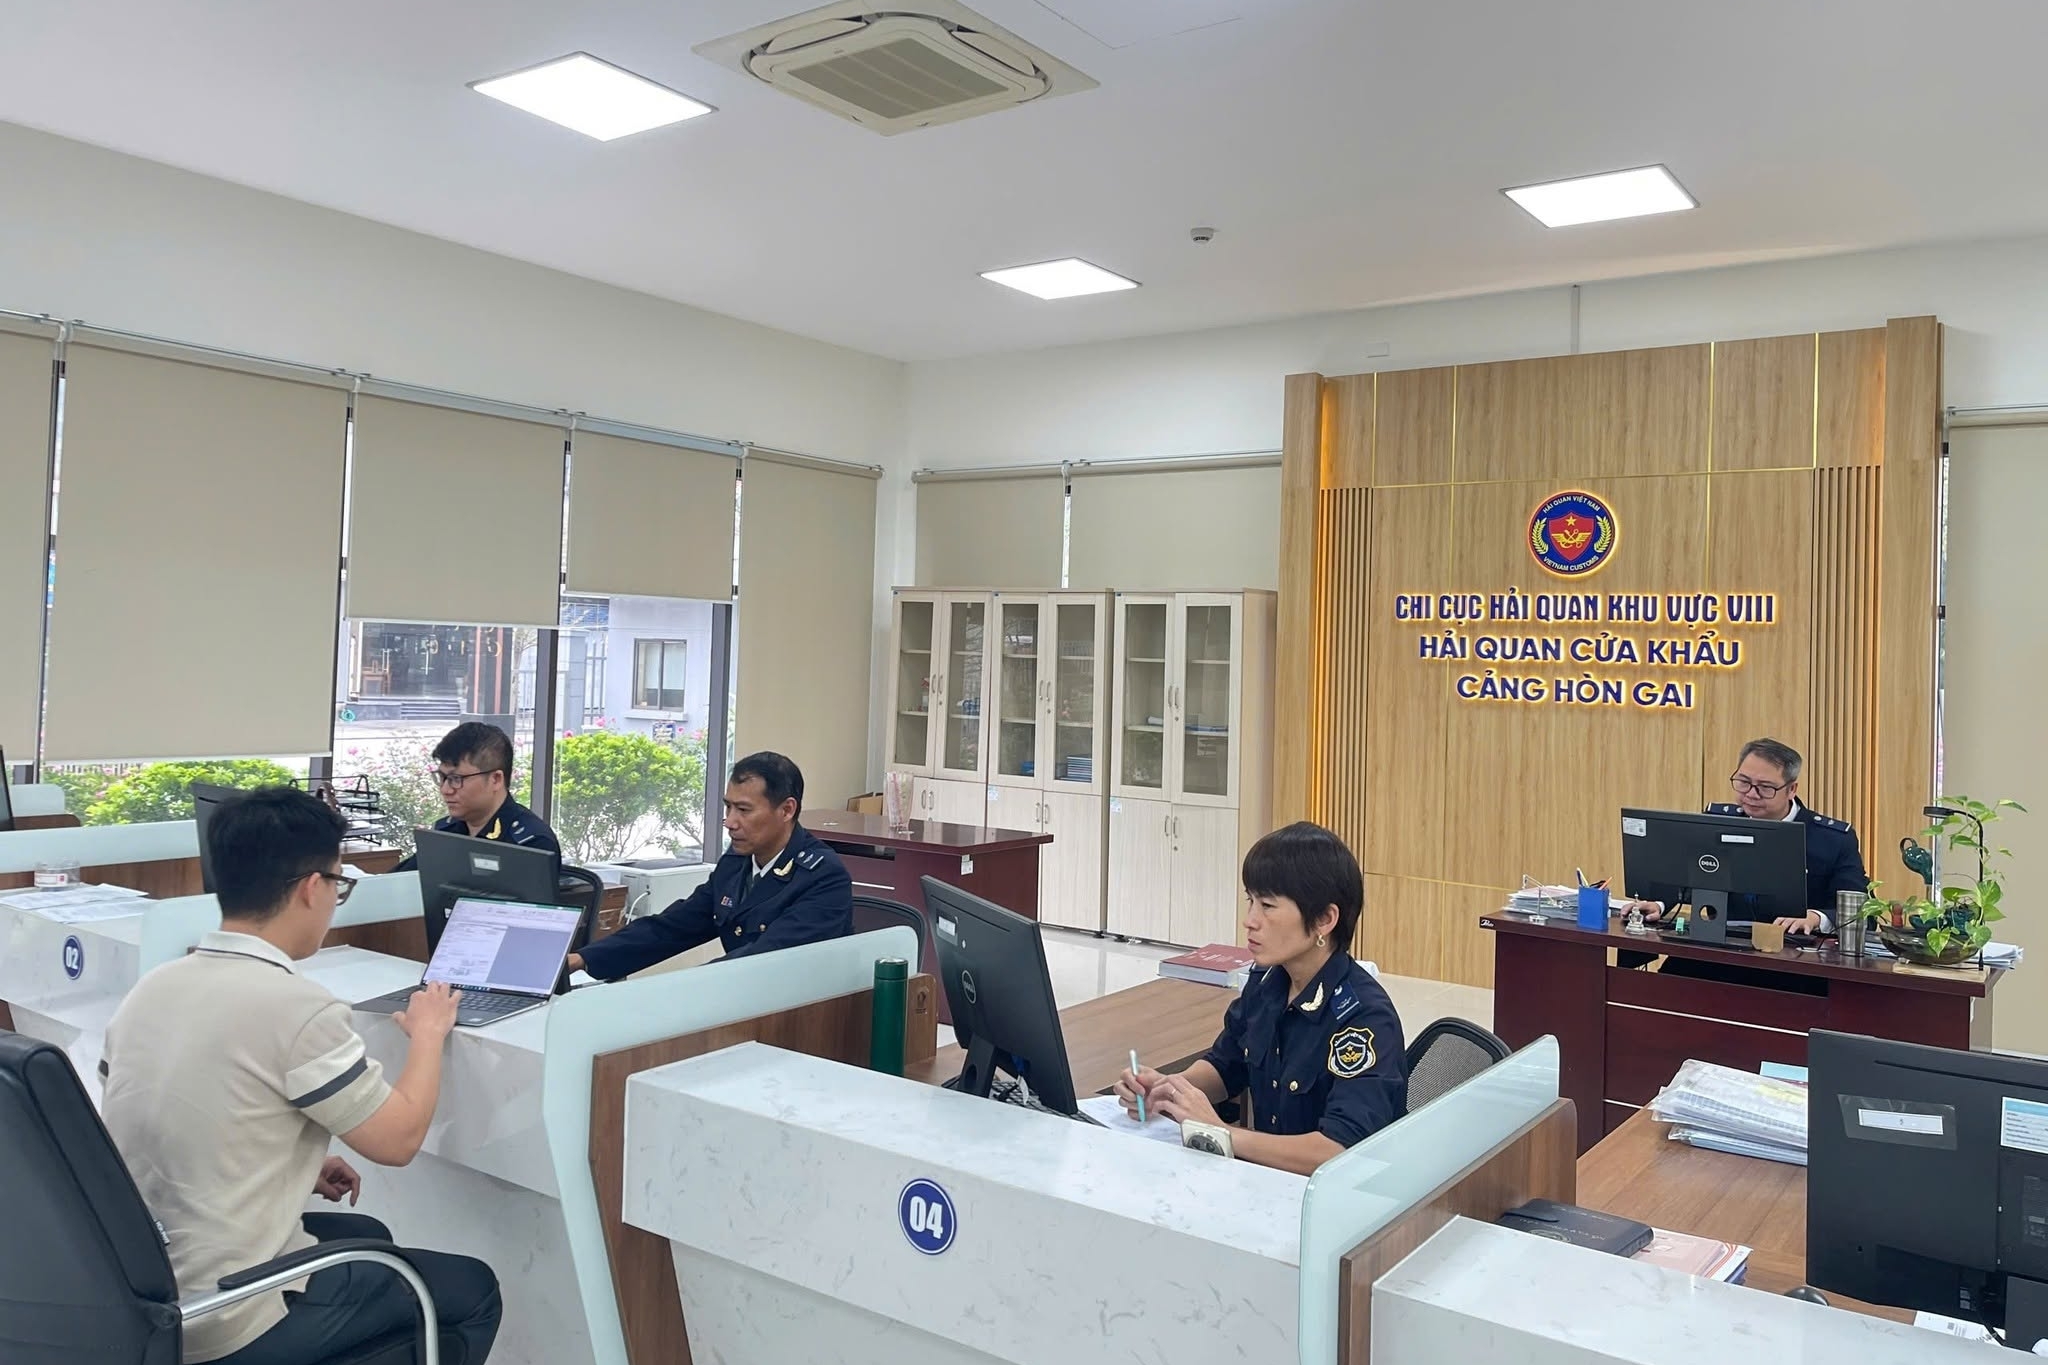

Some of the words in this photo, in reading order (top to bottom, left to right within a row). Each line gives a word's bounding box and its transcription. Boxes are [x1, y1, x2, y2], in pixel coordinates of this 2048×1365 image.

[1553, 496, 1572, 506] QUAN
[1586, 500, 1600, 512] NAM
[1543, 556, 1569, 571] VIETNAM
[1569, 555, 1599, 571] CUSTOMS
[1396, 595, 1431, 619] CHI
[1439, 595, 1482, 625] CỤC
[1490, 587, 1529, 620] HẢI
[1536, 595, 1598, 621] QUAN
[1608, 595, 1657, 621] KHU
[1667, 594, 1717, 628] VỰC
[1727, 595, 1773, 622] VIII
[1420, 630, 1467, 659] HẢI
[1475, 636, 1561, 661] QUAN
[1570, 632, 1638, 663] CỬA
[1648, 630, 1740, 665] KHẨU
[1457, 669, 1545, 701] CẢNG
[1554, 673, 1622, 704] HÒN
[1633, 682, 1692, 708] GAI
[66, 946, 79, 970] 02
[910, 1196, 943, 1239] 04
